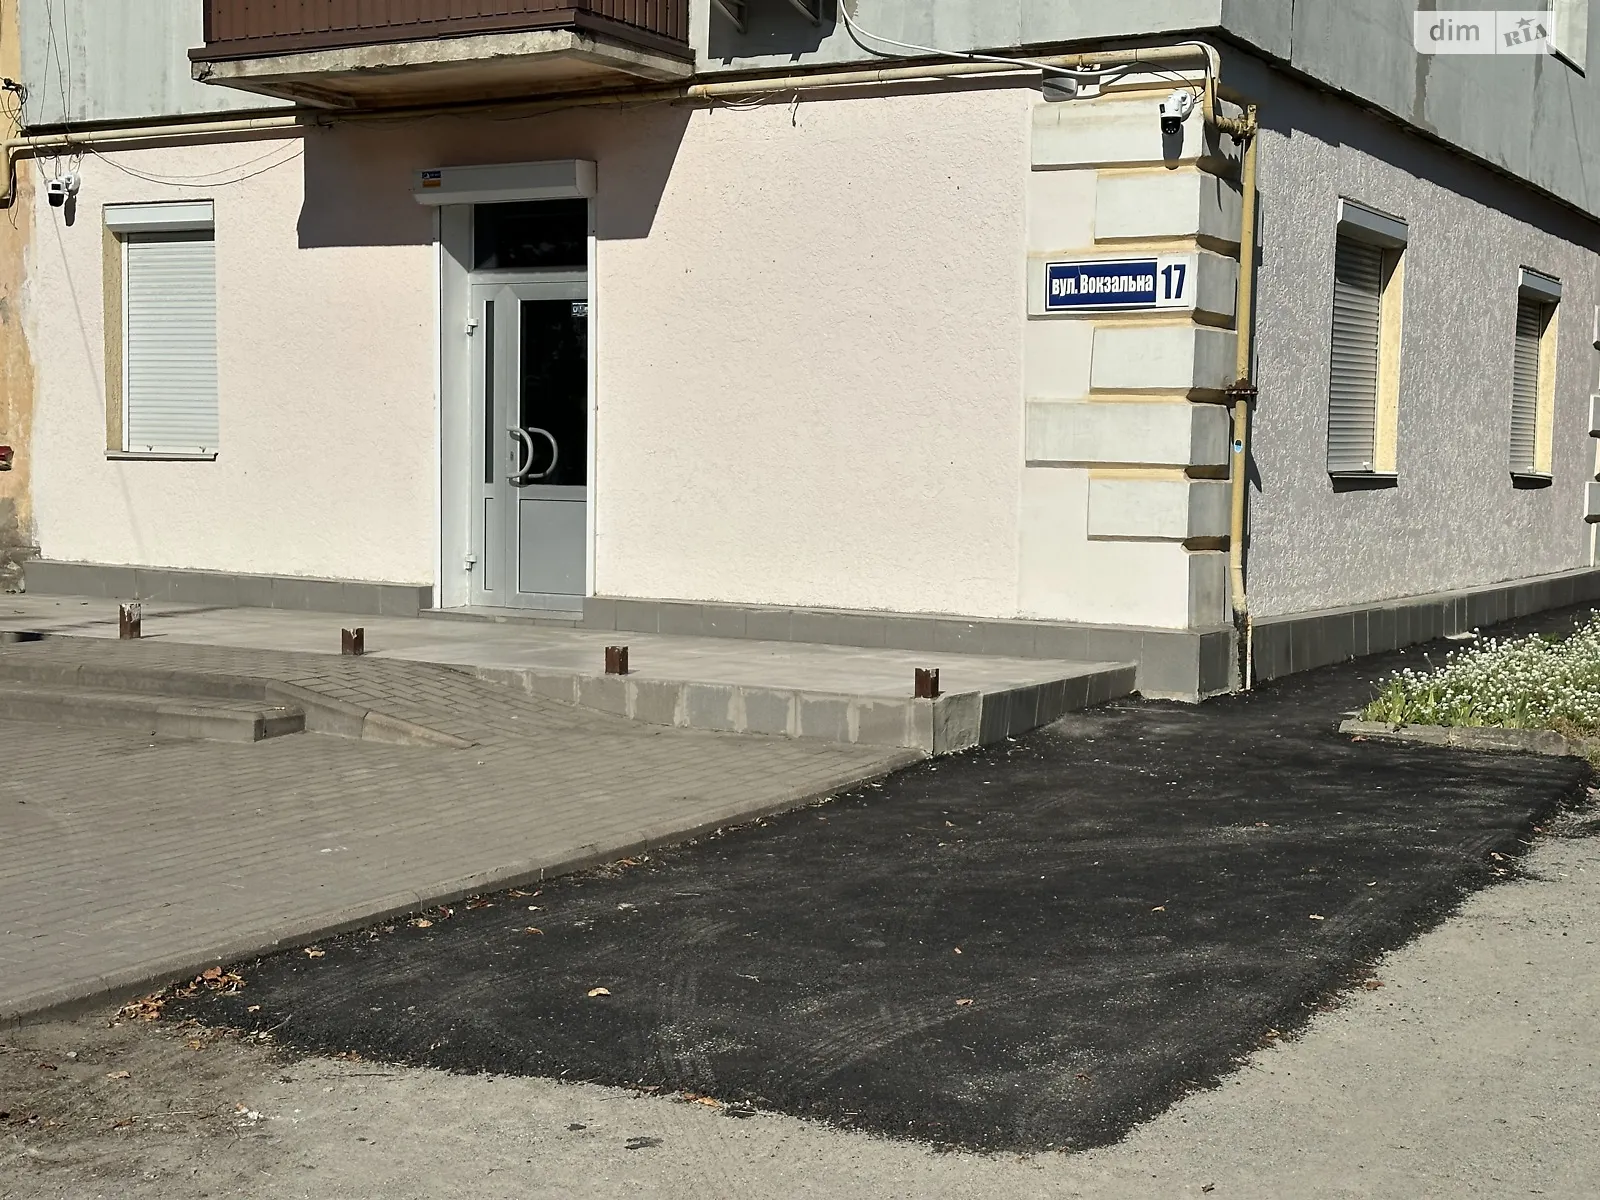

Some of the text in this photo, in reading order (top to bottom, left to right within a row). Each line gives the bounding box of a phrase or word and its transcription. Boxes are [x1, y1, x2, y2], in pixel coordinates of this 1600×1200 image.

[1052, 264, 1186, 300] вул. Вокзальна 17
